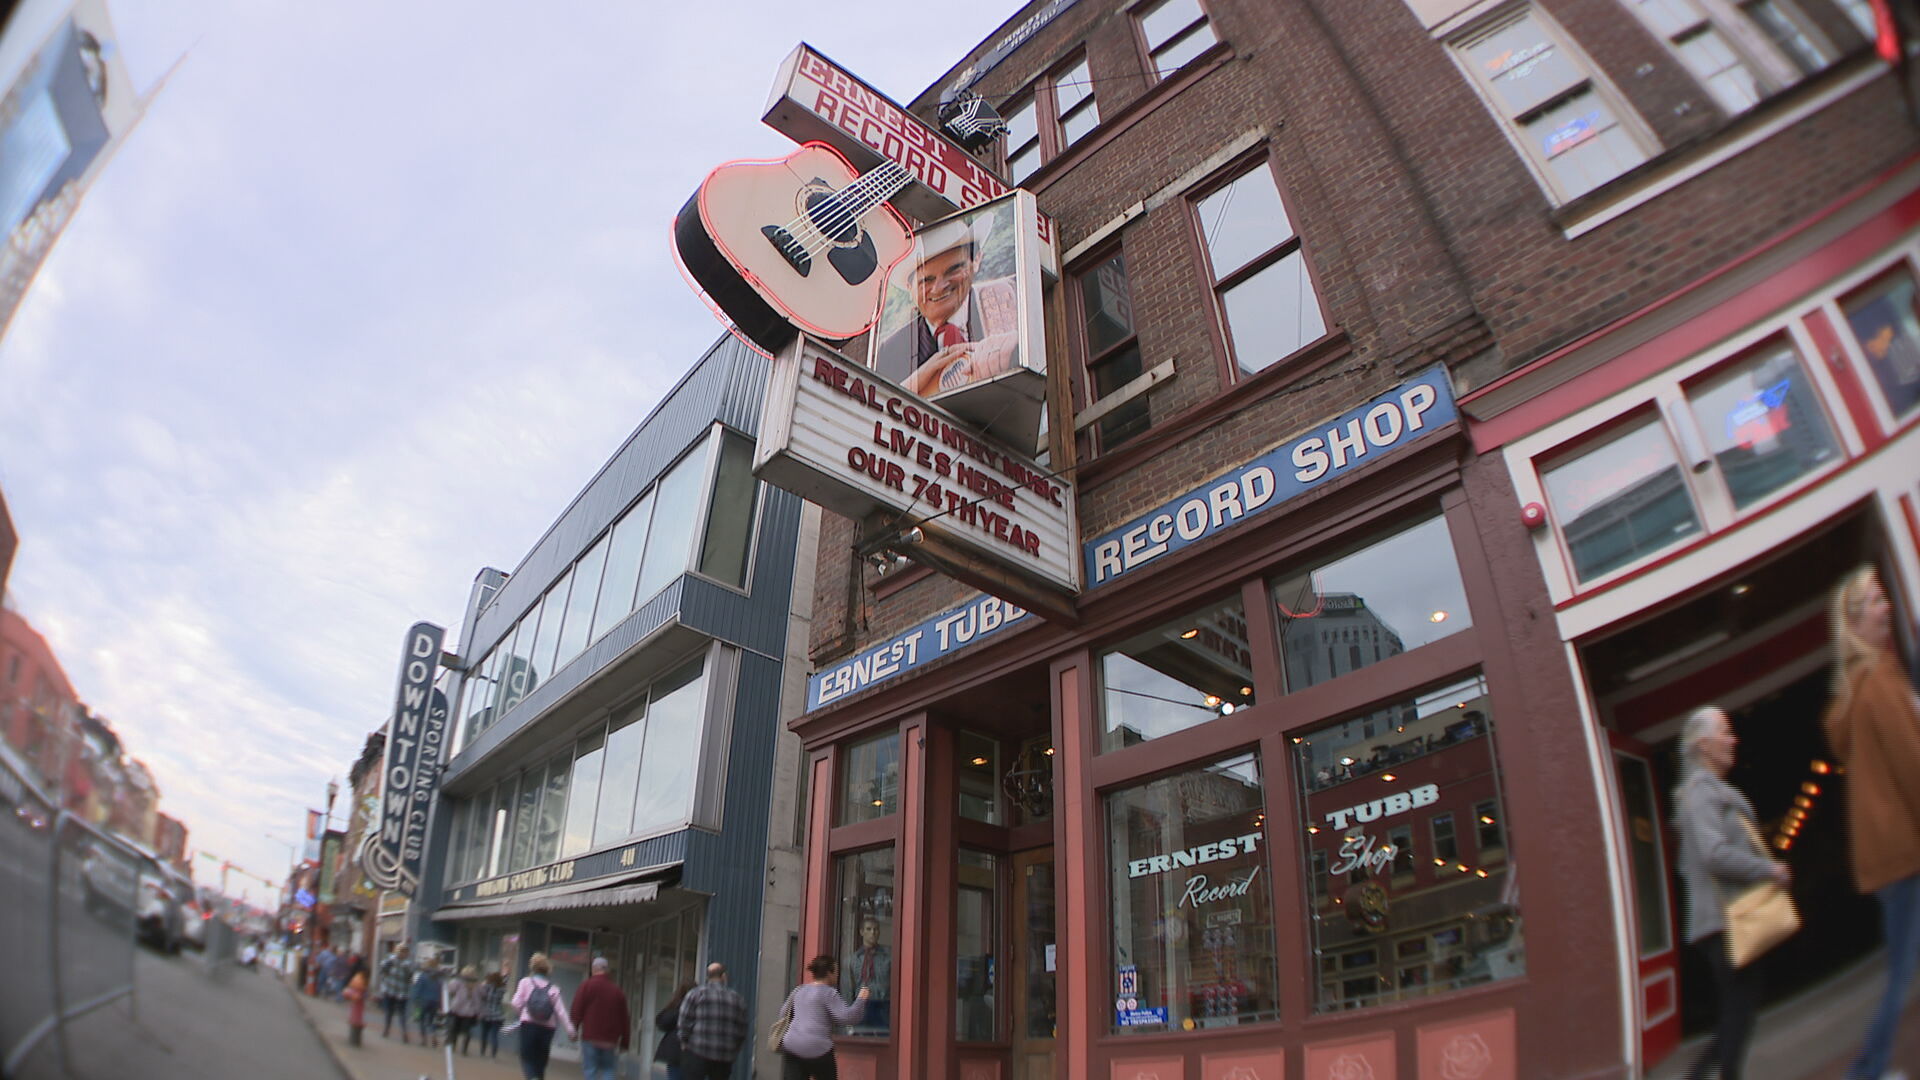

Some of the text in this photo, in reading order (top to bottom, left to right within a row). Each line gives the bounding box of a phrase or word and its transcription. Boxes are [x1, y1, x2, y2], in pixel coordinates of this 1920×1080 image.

[799, 52, 948, 159] ERNEST
[814, 89, 947, 194] RECORD
[813, 357, 1063, 508] REAL COUNTRY MUSIC
[847, 446, 905, 492] OUR
[873, 421, 1017, 512] LIVES HERE
[1094, 466, 1277, 584] RECORD
[1291, 384, 1437, 484] SHOP
[817, 630, 924, 705] ERNEST
[383, 632, 434, 844] DOWNTOWN
[406, 706, 445, 861] SPORTING CLUB
[1325, 783, 1440, 832] TUBB
[1128, 832, 1263, 879] ERNEST
[1178, 865, 1260, 909] Record
[1330, 834, 1399, 876] Shop
